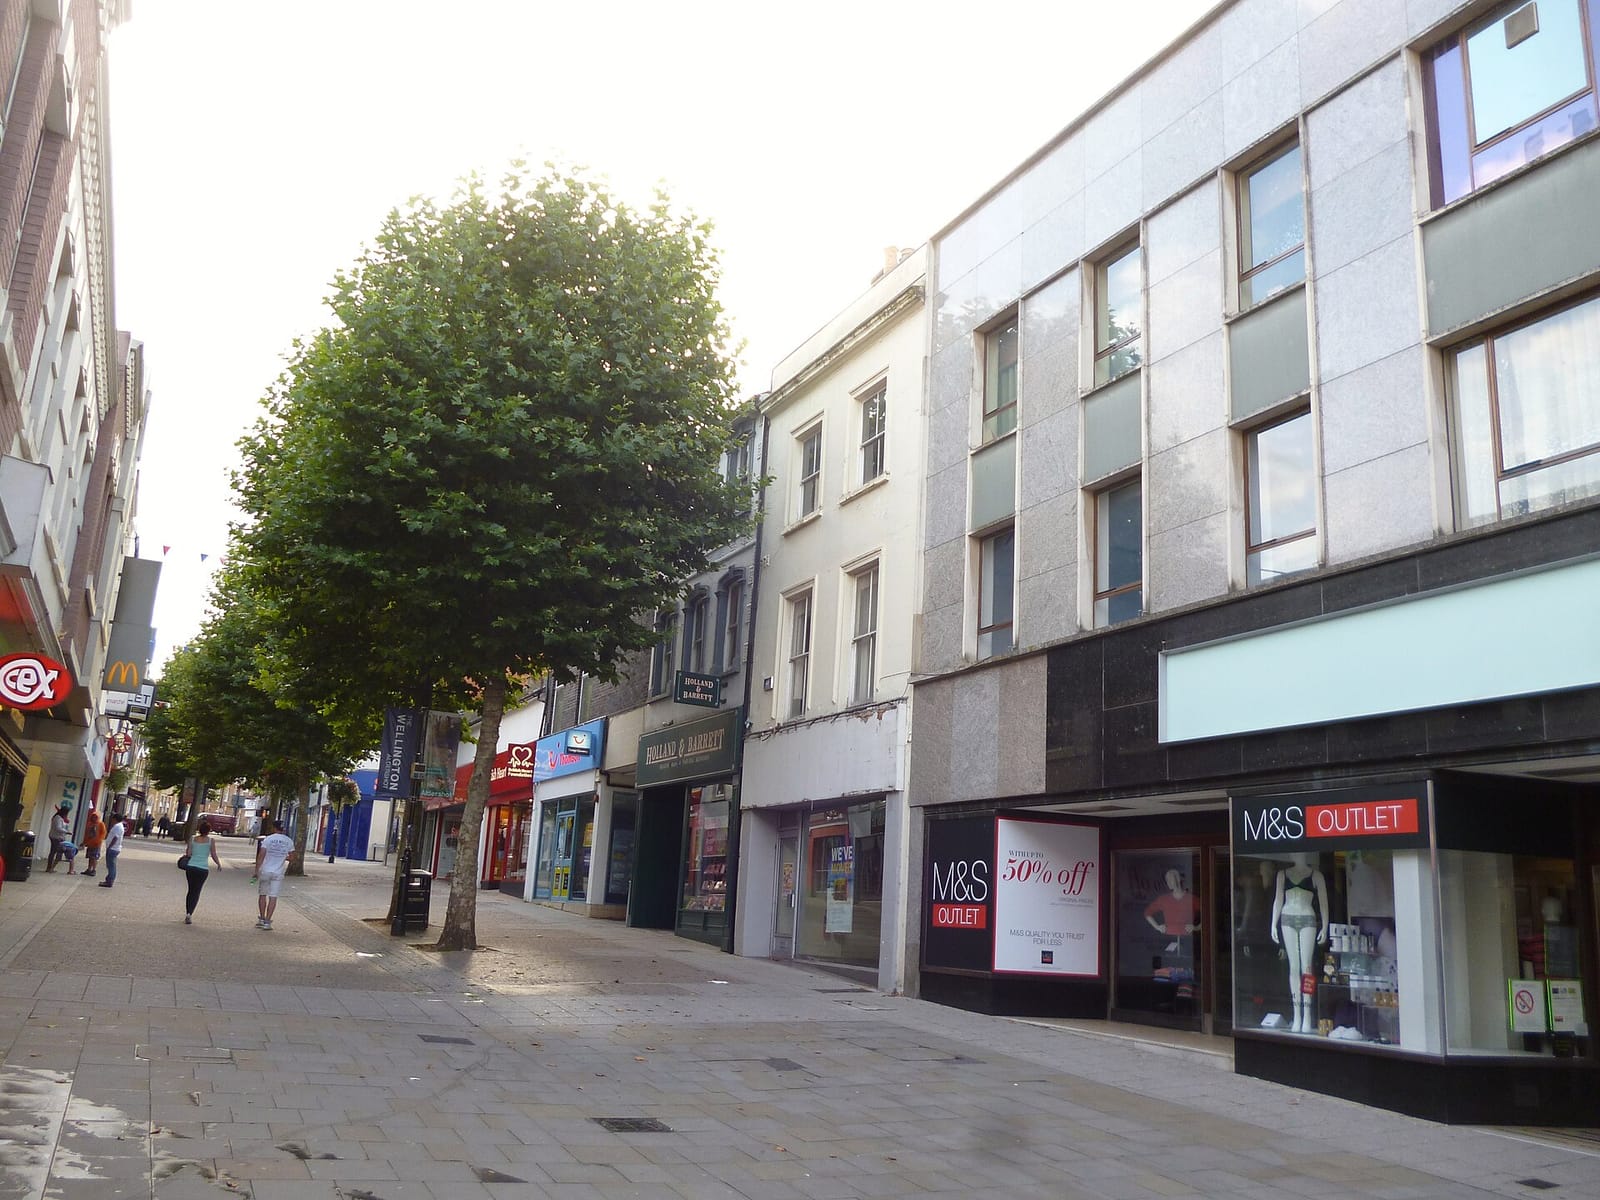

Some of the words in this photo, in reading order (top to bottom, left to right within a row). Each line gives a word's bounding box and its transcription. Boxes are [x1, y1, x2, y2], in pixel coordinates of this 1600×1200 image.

[684, 677, 715, 690] HOLLAND
[695, 685, 702, 693] &
[128, 693, 152, 704] ET
[682, 690, 714, 703] BARRETT
[389, 714, 407, 791] WELLINGTON
[646, 741, 677, 765] HOLLAND
[678, 738, 686, 758] &
[687, 727, 725, 753] BARRETT
[382, 753, 392, 790] ALDERSHOT
[497, 766, 508, 780] Heart
[421, 789, 453, 798] Aldershot
[1243, 805, 1304, 841] M&S
[1317, 804, 1403, 833] OUTLET
[831, 845, 854, 862] WE'VE
[932, 859, 989, 902] M&S
[1002, 858, 1053, 884] 50%
[1057, 860, 1095, 896] off
[938, 907, 980, 925] OUTLET
[1009, 929, 1024, 937] M&S
[1025, 929, 1051, 938] QUALITY
[1051, 931, 1065, 939] YOU
[1066, 932, 1086, 940] TRUST
[1033, 937, 1046, 945] FOR
[1047, 938, 1063, 946] LESS
